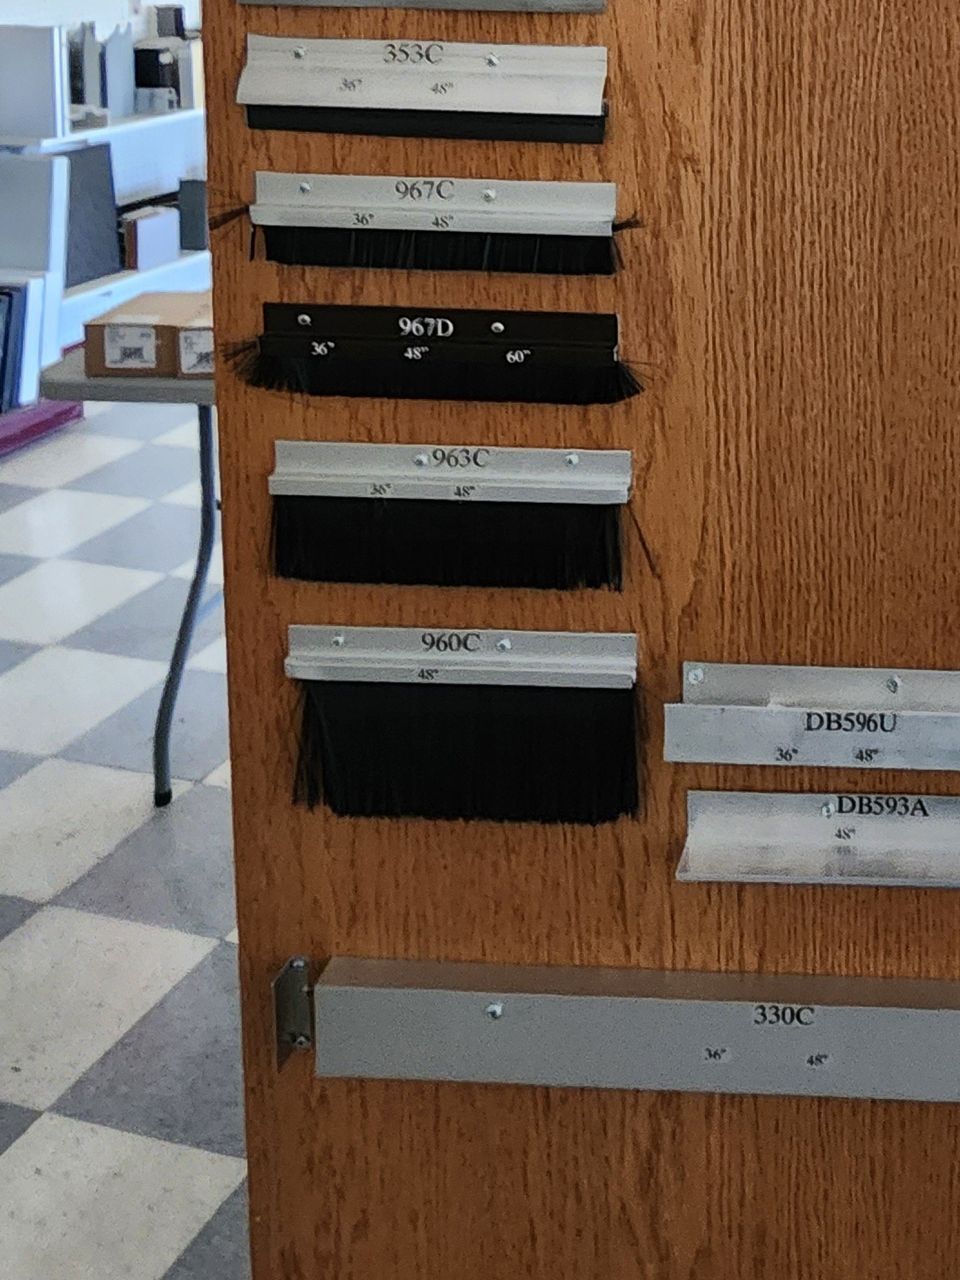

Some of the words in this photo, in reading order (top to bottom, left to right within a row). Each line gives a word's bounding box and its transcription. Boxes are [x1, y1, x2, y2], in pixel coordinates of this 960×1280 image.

[383, 43, 445, 65] 353C
[395, 179, 455, 201] 967C
[352, 212, 375, 226] 36"
[398, 317, 454, 338] 967D
[311, 341, 336, 356] 36"
[403, 345, 430, 360] 48"
[506, 349, 532, 363] 60"
[432, 448, 491, 469] 963C
[421, 632, 481, 652] 960C
[804, 711, 898, 733] DB596U
[775, 747, 799, 762] 36"
[855, 747, 880, 762] 48"
[836, 795, 929, 817] DB593A
[753, 1005, 815, 1026] 330C
